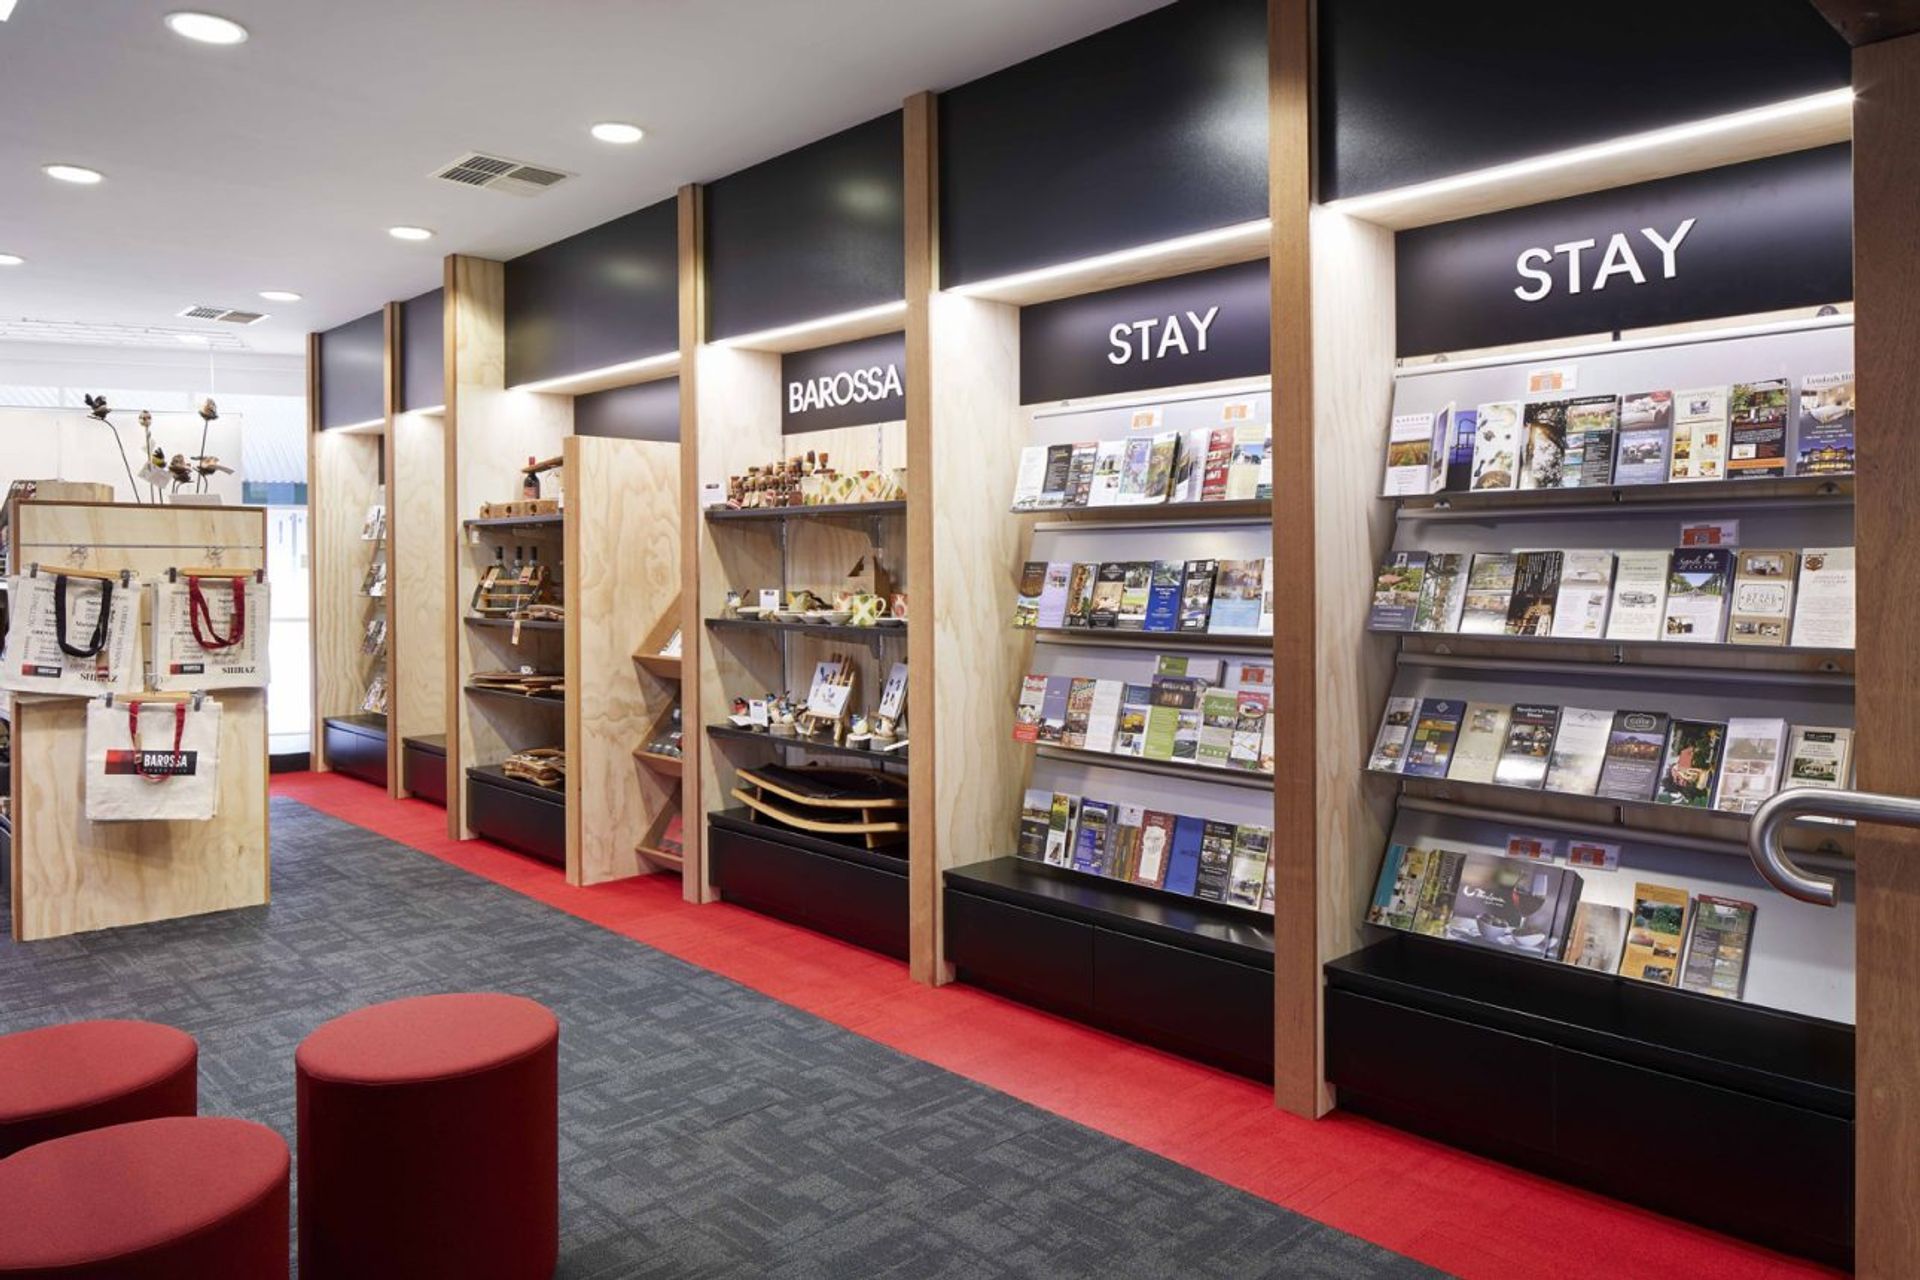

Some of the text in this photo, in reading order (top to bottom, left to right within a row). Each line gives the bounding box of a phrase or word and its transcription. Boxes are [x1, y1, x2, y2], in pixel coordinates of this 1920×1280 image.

[1514, 217, 1697, 302] STAY
[1107, 305, 1220, 366] STAY
[788, 363, 905, 415] BAROSSA
[143, 754, 188, 768] BAROSSA
